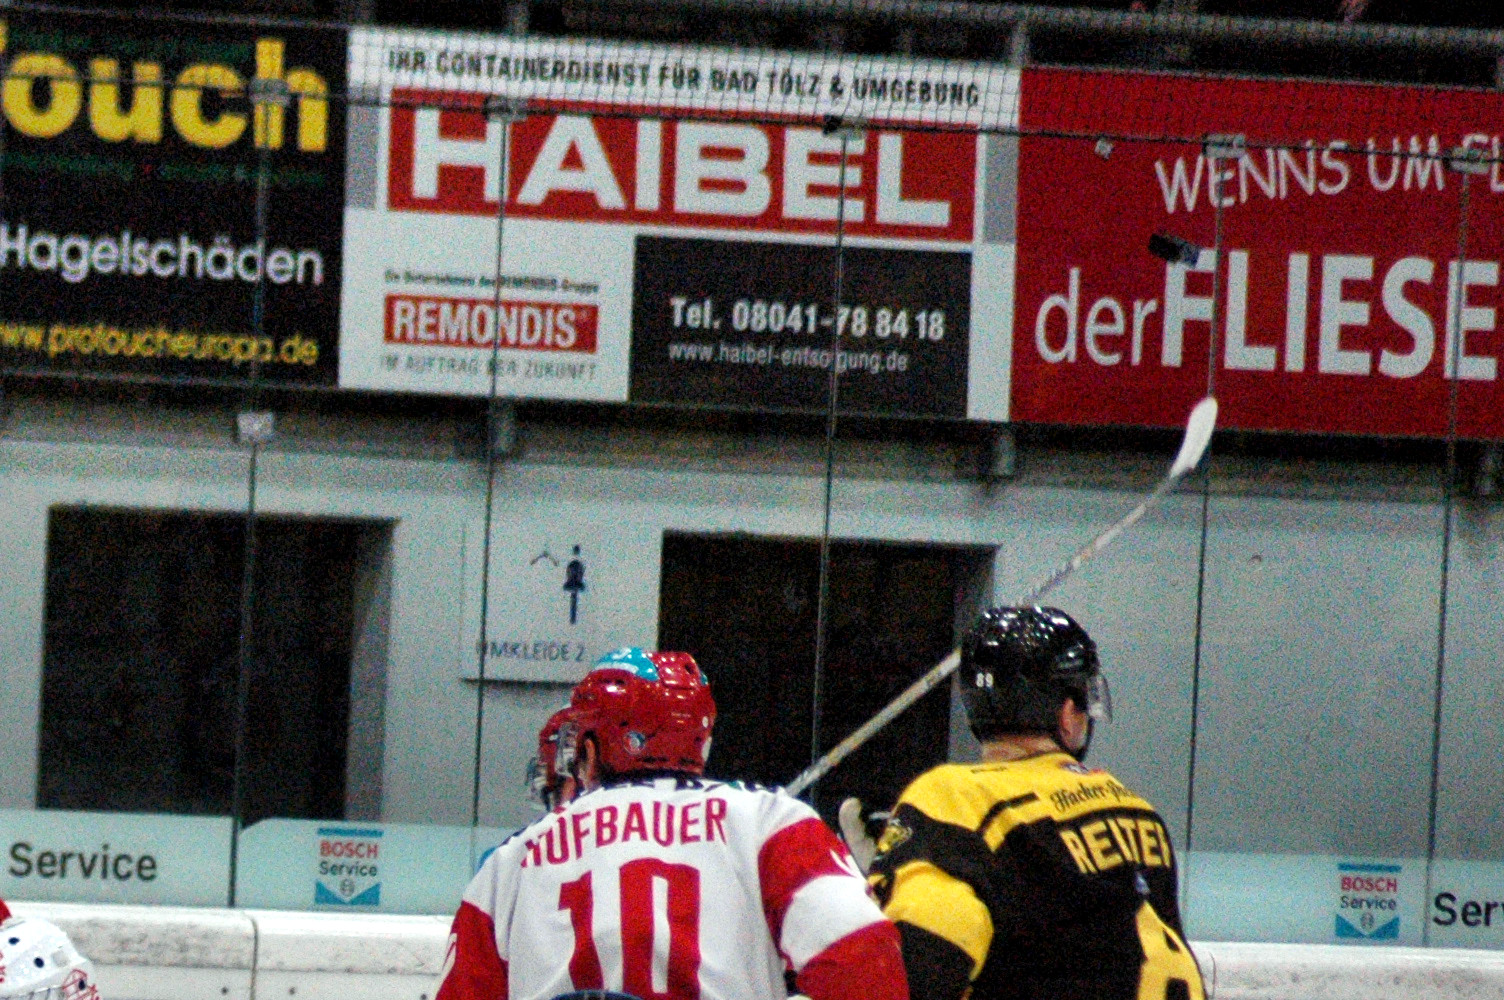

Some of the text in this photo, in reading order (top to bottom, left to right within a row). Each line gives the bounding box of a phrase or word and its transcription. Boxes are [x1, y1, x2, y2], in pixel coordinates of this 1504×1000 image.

[437, 51, 650, 88] CONTAINERDIENST
[659, 62, 701, 89] FÜR
[710, 68, 758, 94] BAD
[767, 67, 820, 98] TÖLZ
[853, 75, 980, 107] UMGEBUNG
[410, 105, 953, 229] HAIBEL
[1154, 138, 1350, 214] WENNS
[1367, 133, 1446, 192] UM
[393, 298, 577, 349] REMONDIS
[670, 298, 945, 341] Tel. 08041-78 84 18
[669, 341, 908, 374] www.haibel-entsogung.de
[8, 841, 158, 882] Service
[319, 860, 378, 878] Service
[320, 839, 379, 860] BOSCH
[1340, 875, 1398, 894] BOSCH
[1340, 895, 1398, 911] Service
[1432, 891, 1504, 928] Ser
